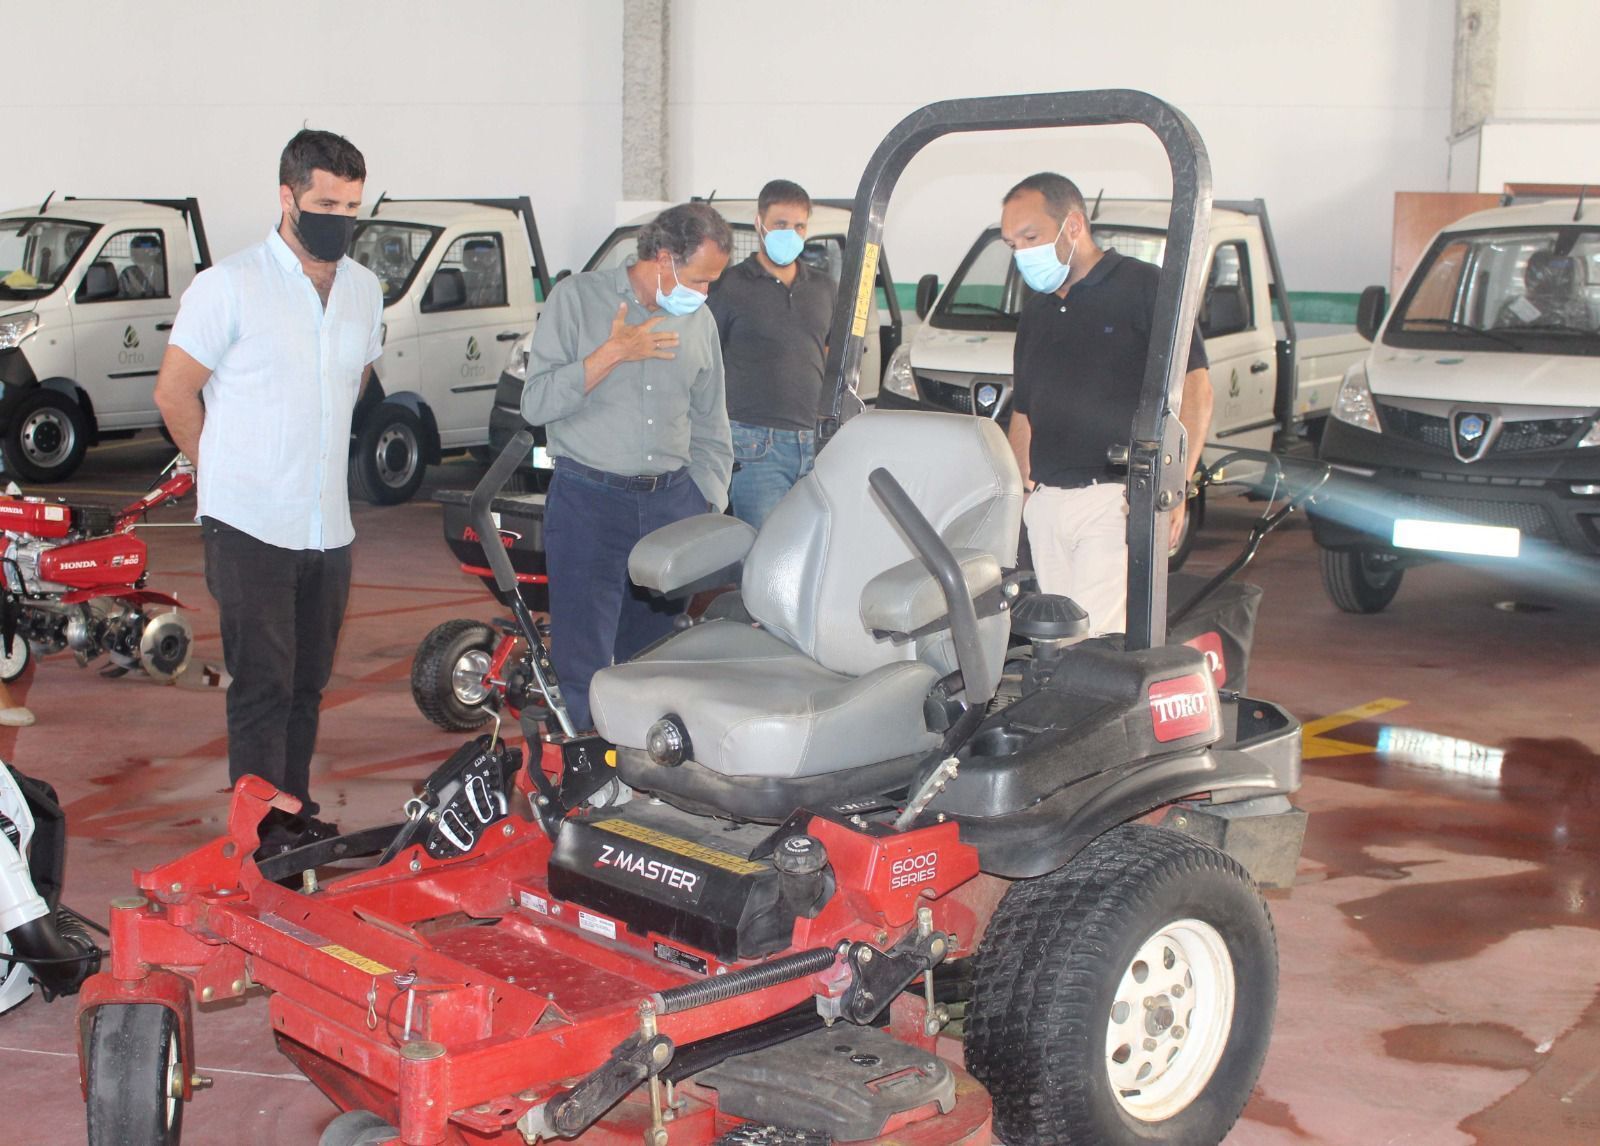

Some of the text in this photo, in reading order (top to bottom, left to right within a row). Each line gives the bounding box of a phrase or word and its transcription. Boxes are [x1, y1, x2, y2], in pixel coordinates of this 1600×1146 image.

[118, 350, 145, 365] Orto
[460, 363, 486, 378] Orto
[60, 559, 98, 570] HONDA
[1154, 693, 1205, 723] TORO
[598, 844, 614, 865] Z
[613, 850, 697, 893] MASTER
[892, 852, 937, 875] 6000
[891, 867, 936, 890] SERIES
